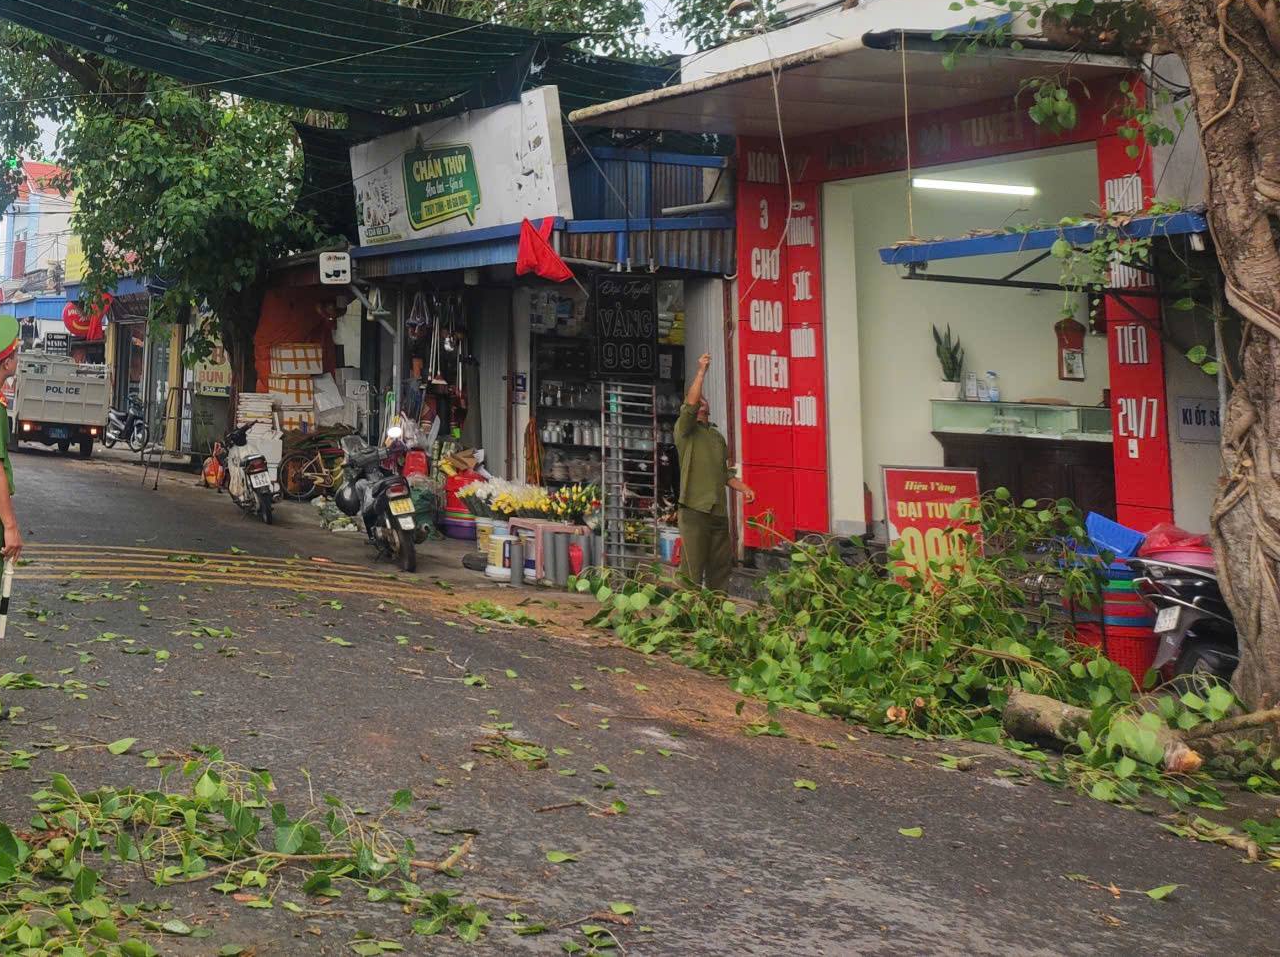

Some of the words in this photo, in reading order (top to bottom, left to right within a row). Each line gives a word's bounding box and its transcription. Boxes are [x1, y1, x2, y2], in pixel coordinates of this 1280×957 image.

[759, 199, 769, 230] 3
[749, 299, 783, 333] GIAO
[602, 342, 652, 370] 999
[747, 349, 789, 392] THIỆN
[45, 385, 81, 395] POLICE
[1117, 396, 1158, 439] 24/7
[1182, 408, 1193, 426] KI
[930, 481, 957, 494] Vàng
[897, 501, 923, 521] ĐẠI
[926, 501, 971, 520] TUYT
